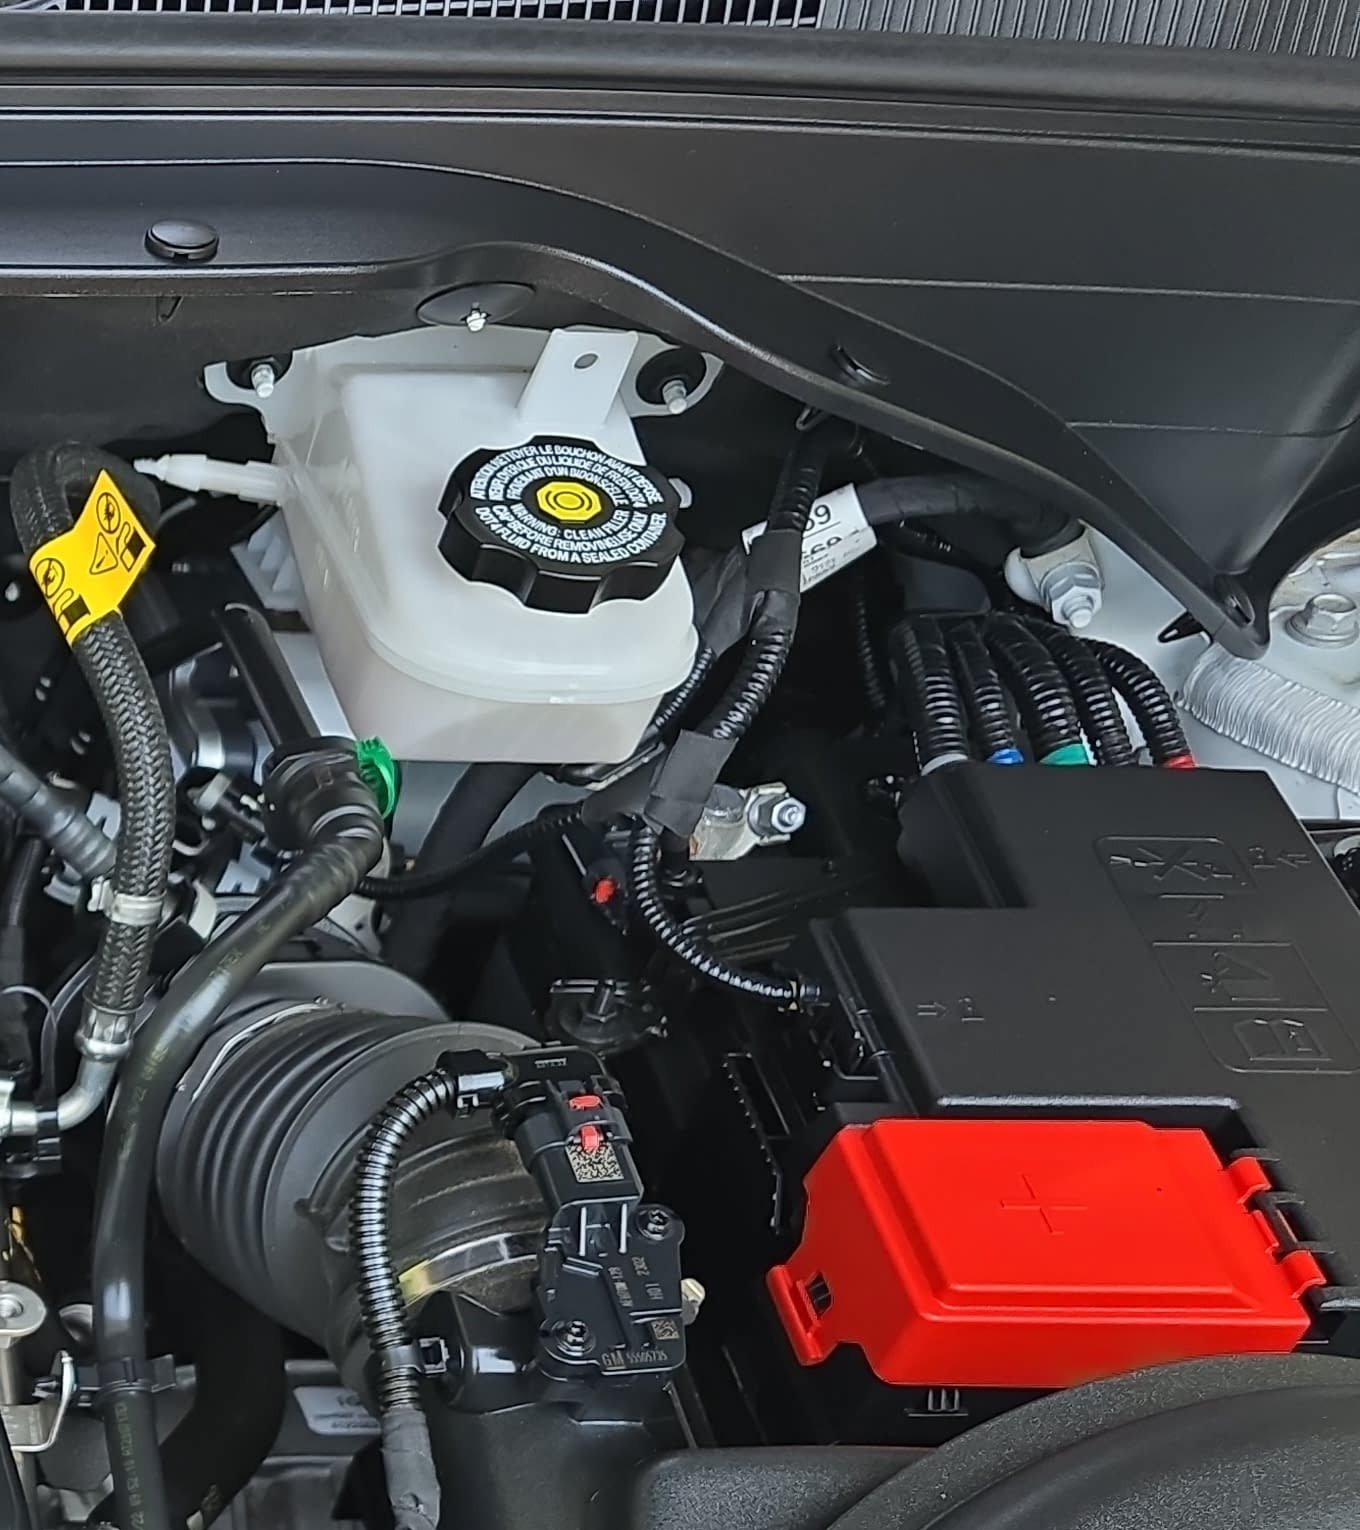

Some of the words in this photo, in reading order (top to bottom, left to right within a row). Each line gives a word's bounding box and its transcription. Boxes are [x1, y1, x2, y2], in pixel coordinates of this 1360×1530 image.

[537, 455, 555, 467] DU
[553, 456, 593, 471] LIQUIDE
[592, 463, 608, 476] DE
[538, 445, 554, 456] LE
[554, 445, 605, 464] BOUCHON
[603, 456, 637, 478] AVANT
[492, 504, 515, 525] CAP
[508, 519, 554, 547] BEFORE
[628, 510, 649, 538] ONLY
[495, 524, 532, 549] FLUID
[529, 543, 569, 562] FROM
[570, 550, 581, 563] A
[582, 545, 630, 564] SEALED
[625, 511, 668, 555] CONTAINER
[563, 525, 606, 541] CLEAN
[603, 509, 630, 535] FILLER
